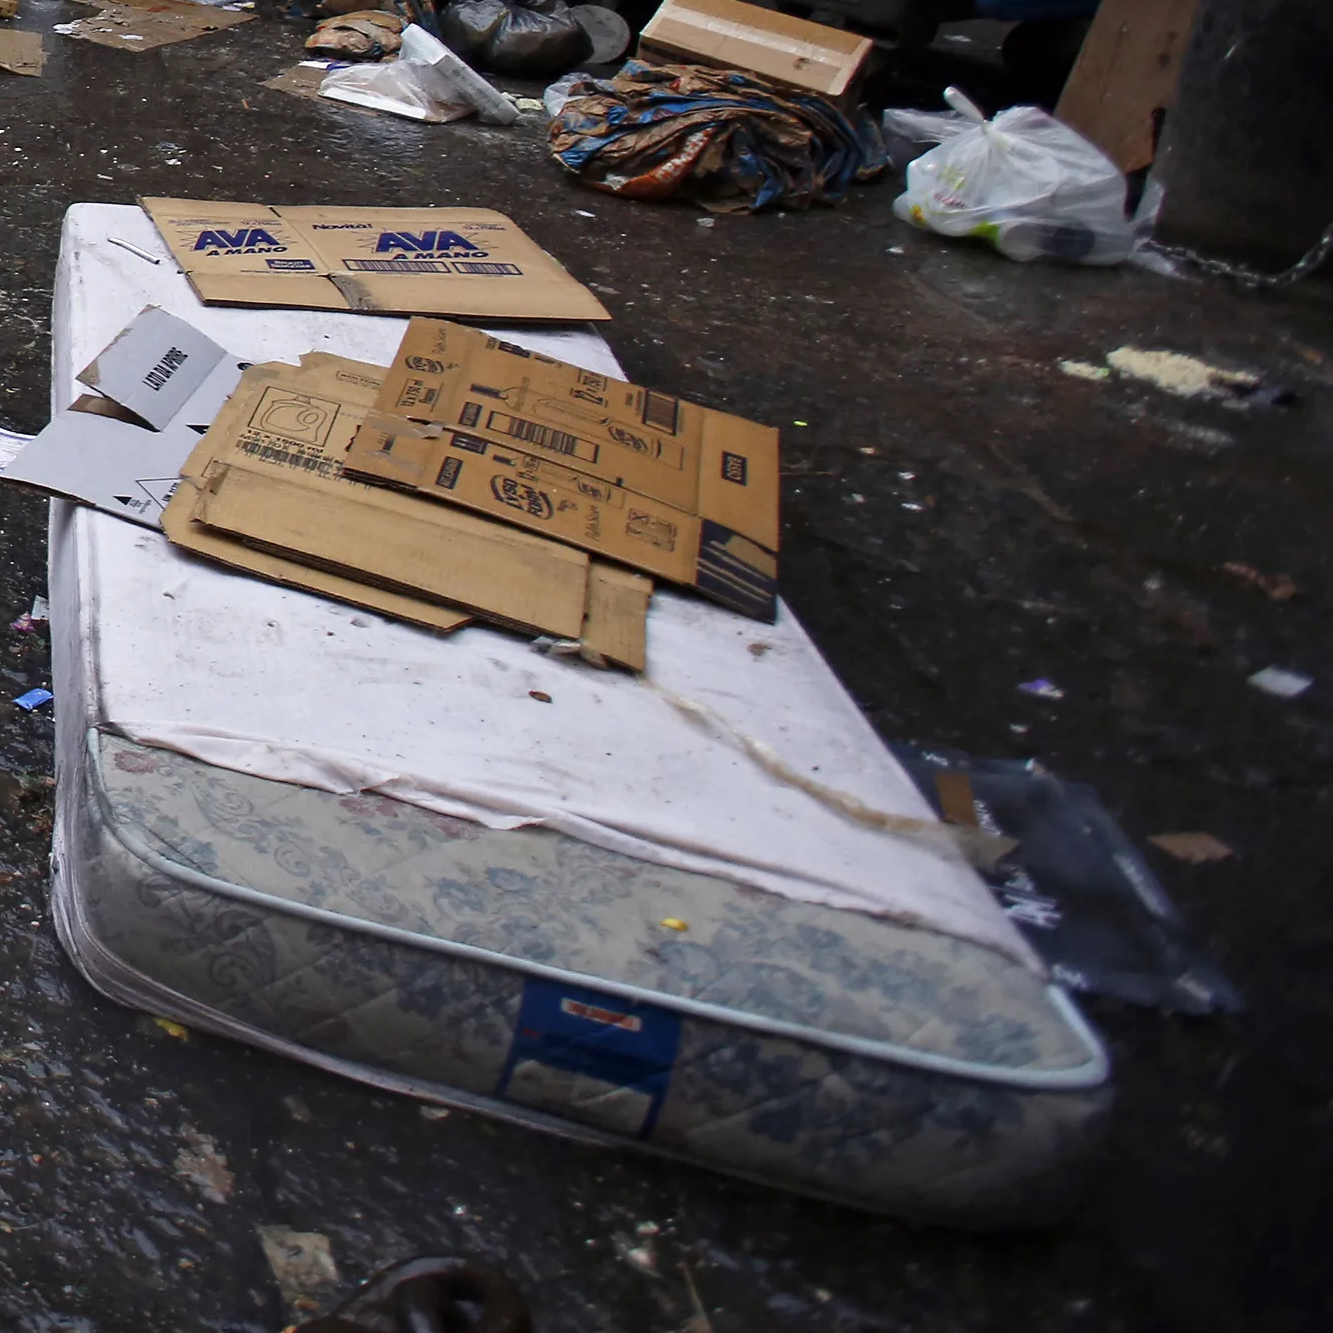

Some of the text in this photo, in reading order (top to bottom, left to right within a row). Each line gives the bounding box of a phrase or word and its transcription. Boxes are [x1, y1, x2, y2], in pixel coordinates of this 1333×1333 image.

[193, 228, 281, 251] AVA
[375, 231, 479, 252] AVA
[224, 247, 288, 256] MANO
[416, 251, 490, 259] MANO
[141, 370, 167, 391] LATO
[153, 363, 174, 378] DA
[503, 477, 522, 509] LYSO
[525, 485, 540, 516] FORM
